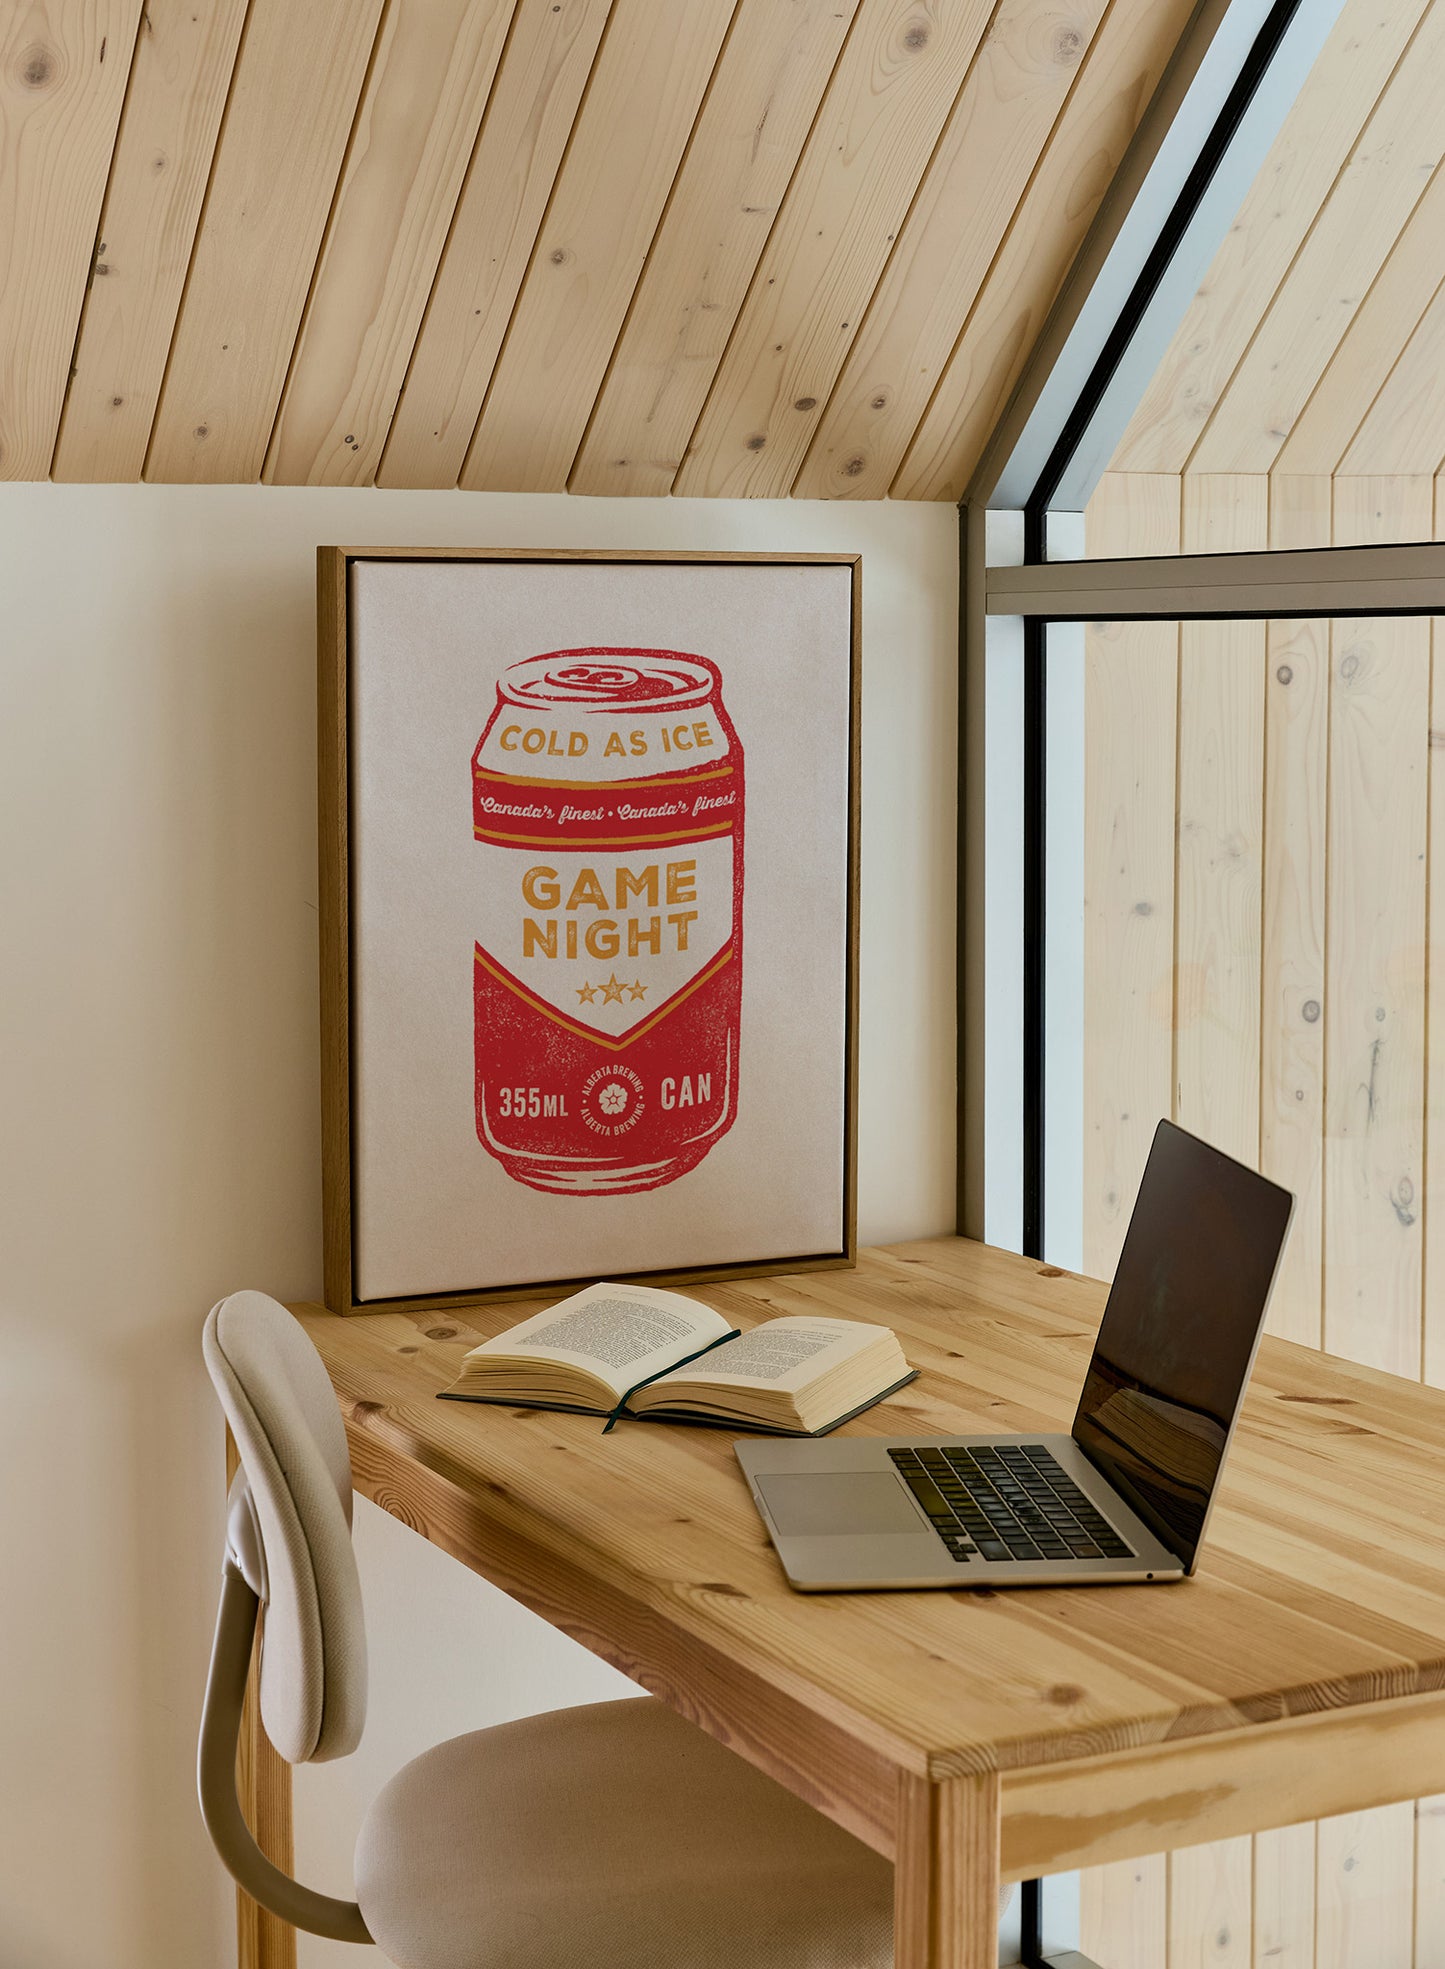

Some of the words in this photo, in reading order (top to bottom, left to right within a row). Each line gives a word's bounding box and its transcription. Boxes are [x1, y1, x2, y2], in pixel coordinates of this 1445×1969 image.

[500, 725, 589, 757] COLD
[603, 730, 648, 757] AS
[661, 721, 714, 753] ICE
[480, 796, 555, 820] Canada's
[558, 805, 604, 824] finest
[616, 800, 688, 820] Canada's
[692, 791, 736, 816] finest
[521, 859, 697, 910] GAME
[522, 910, 698, 960] NIGHT
[582, 1066, 611, 1096] ALBERTA
[613, 1064, 644, 1093] BREWING
[661, 1072, 711, 1110] CAN
[500, 1087, 568, 1117] 355ML
[580, 1108, 611, 1136] ALBERTA
[613, 1102, 646, 1136] BREWING
